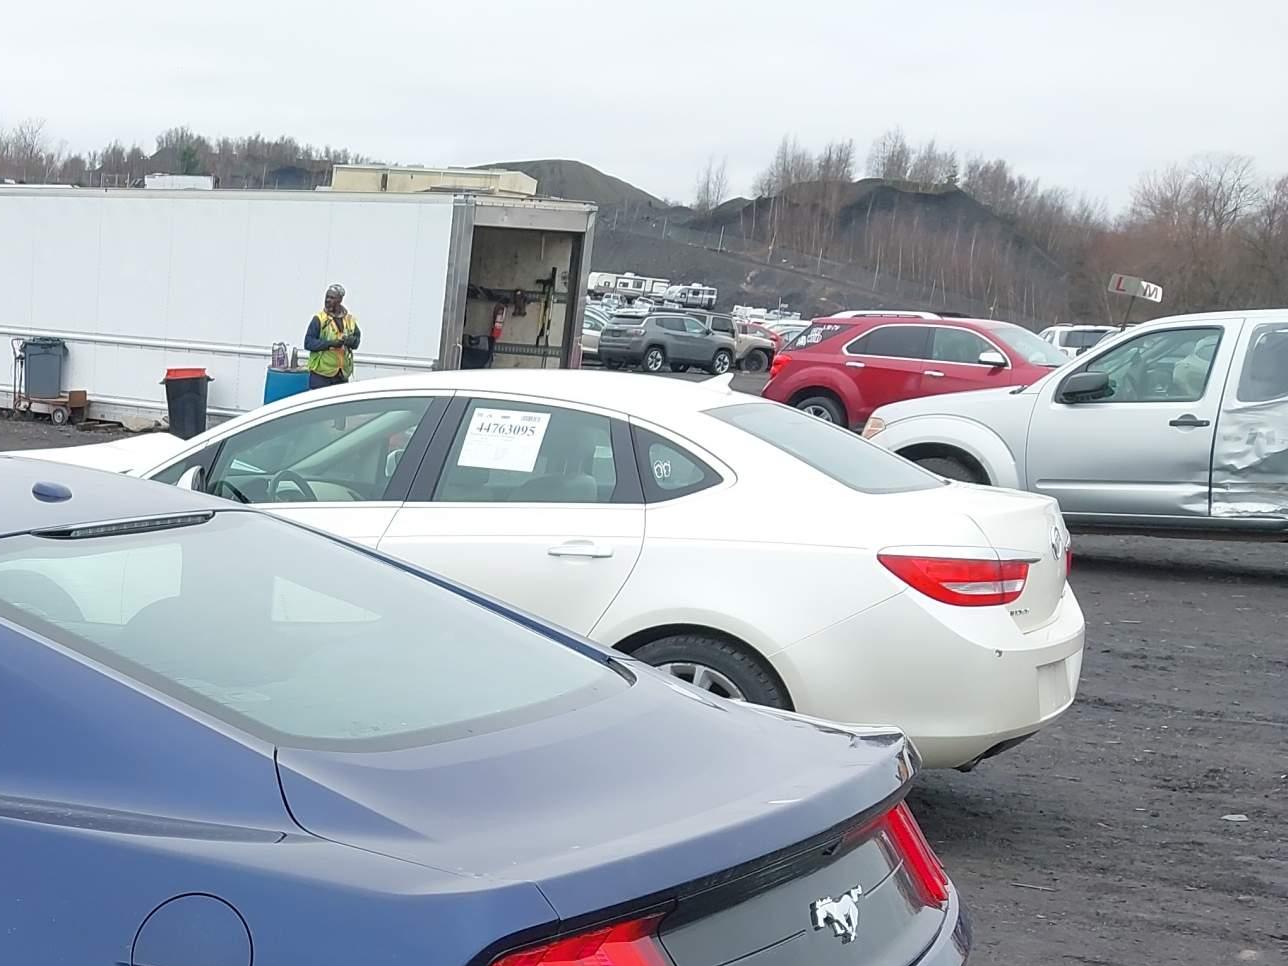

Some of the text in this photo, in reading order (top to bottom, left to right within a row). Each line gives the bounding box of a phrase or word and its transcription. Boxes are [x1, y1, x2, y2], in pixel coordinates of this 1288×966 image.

[1115, 277, 1126, 291] L
[1143, 284, 1159, 299] M
[476, 422, 536, 436] 44763095
